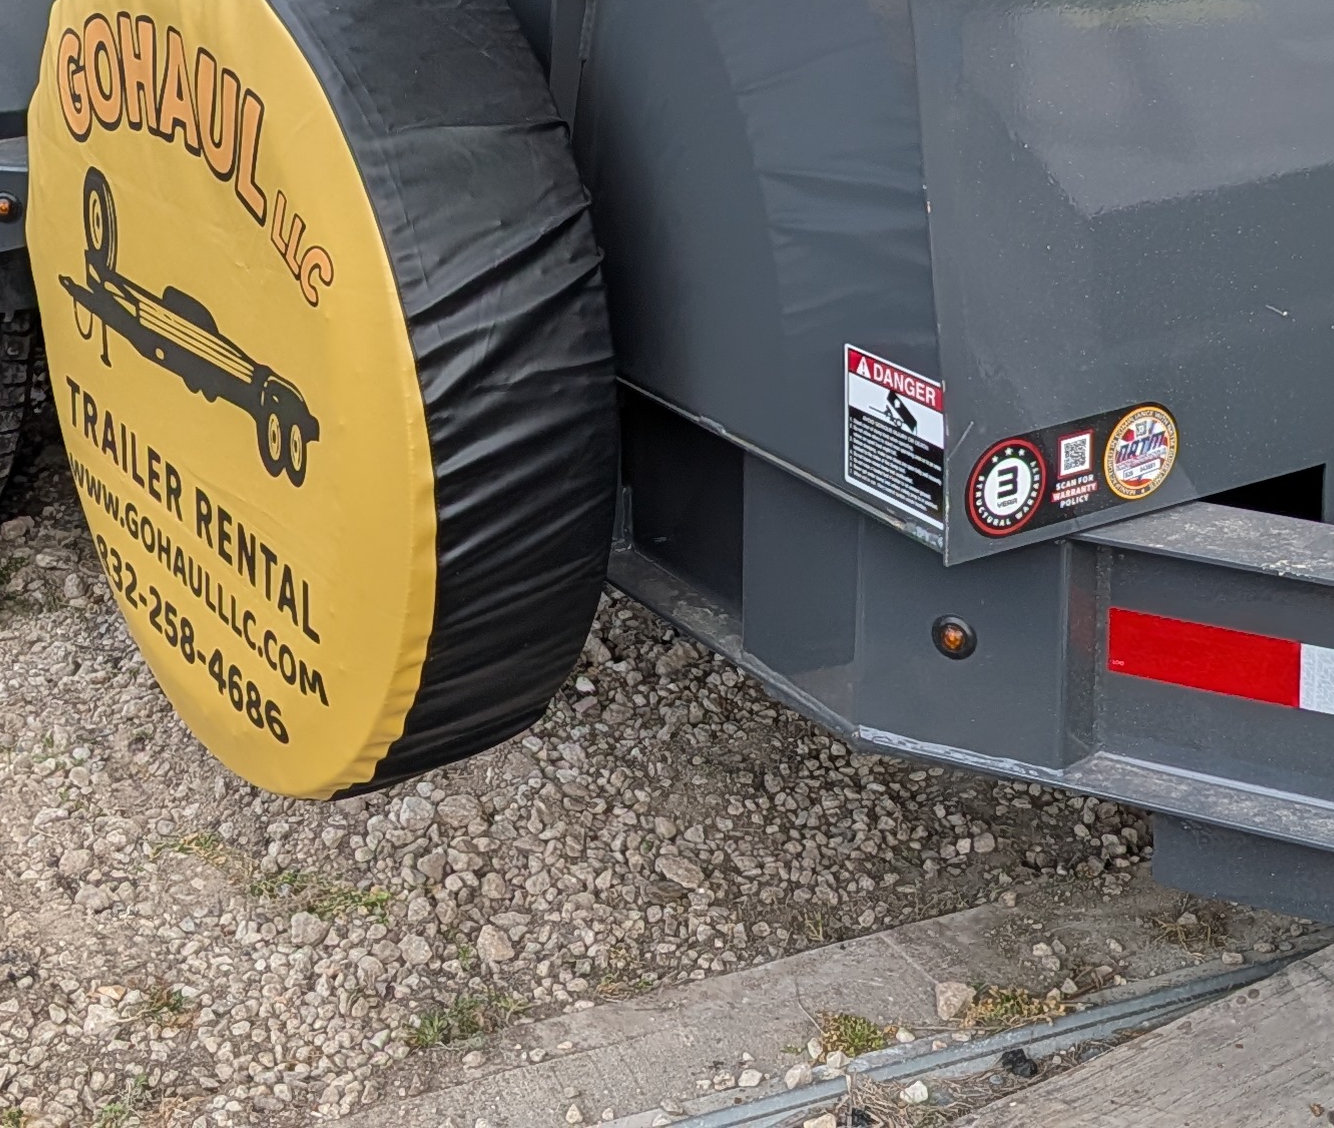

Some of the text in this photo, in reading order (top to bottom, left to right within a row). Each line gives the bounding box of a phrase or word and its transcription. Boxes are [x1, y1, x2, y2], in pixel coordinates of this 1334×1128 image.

[57, 11, 334, 308] GOHAUL LLC
[873, 362, 937, 406] DANGER
[66, 375, 320, 644] TRAILER RENTAL
[975, 460, 1041, 527] STRUCTURAL WARRANTY
[997, 465, 1018, 499] 3
[1053, 482, 1097, 501] WARRANTY
[1056, 474, 1094, 491] SCAN FOR
[1060, 494, 1089, 509] POLICY
[69, 452, 329, 707] WWW.GOHAULLLC.COM
[96, 534, 289, 744] 832-258-4686
